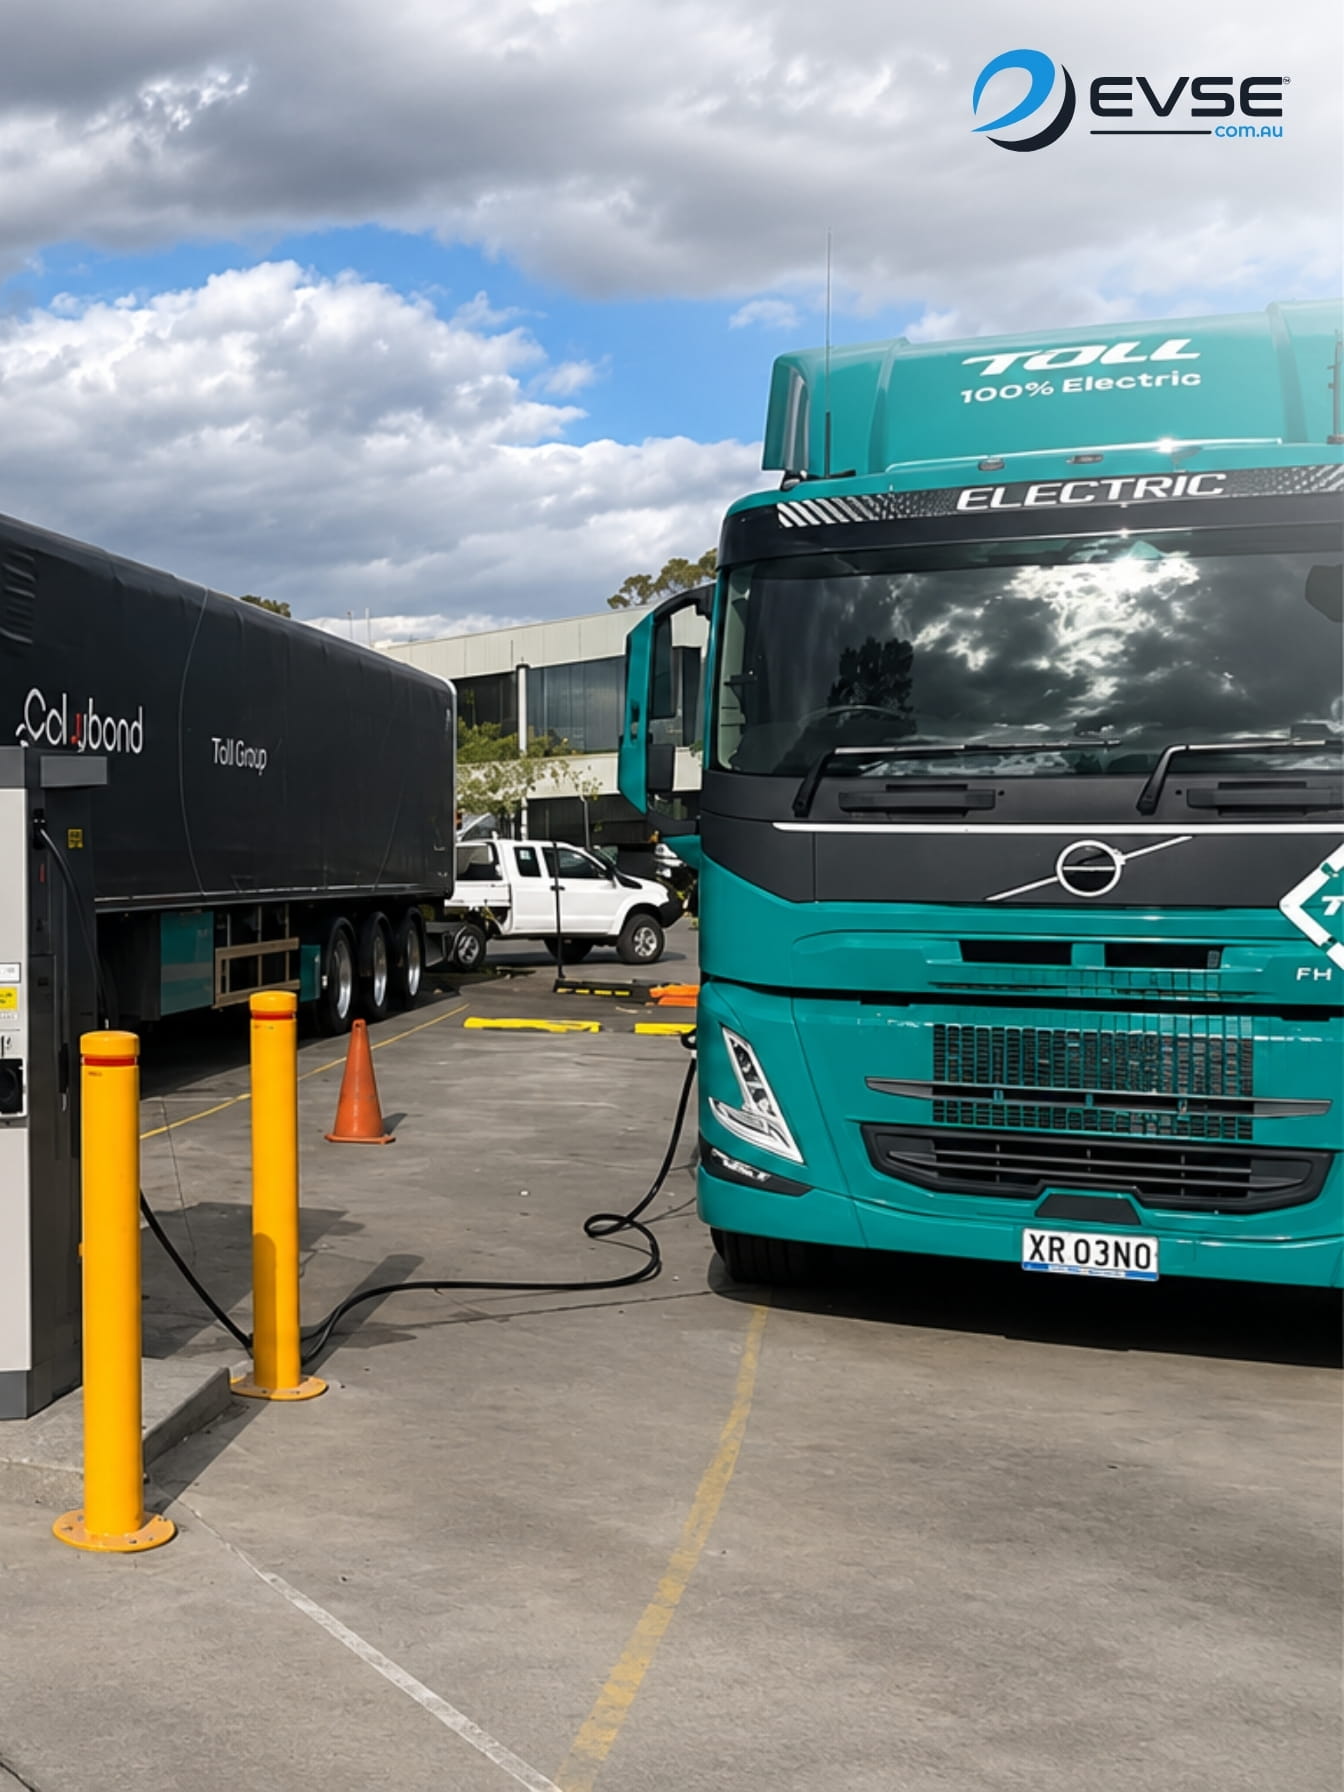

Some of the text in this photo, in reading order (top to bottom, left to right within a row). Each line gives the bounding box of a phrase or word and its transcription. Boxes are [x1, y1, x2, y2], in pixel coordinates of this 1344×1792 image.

[961, 338, 1201, 376] TOLL
[961, 370, 1201, 404] 100% Electric
[956, 473, 1227, 511] ELECTRIC
[1296, 967, 1333, 981] FH
[1029, 1233, 1065, 1263] XR
